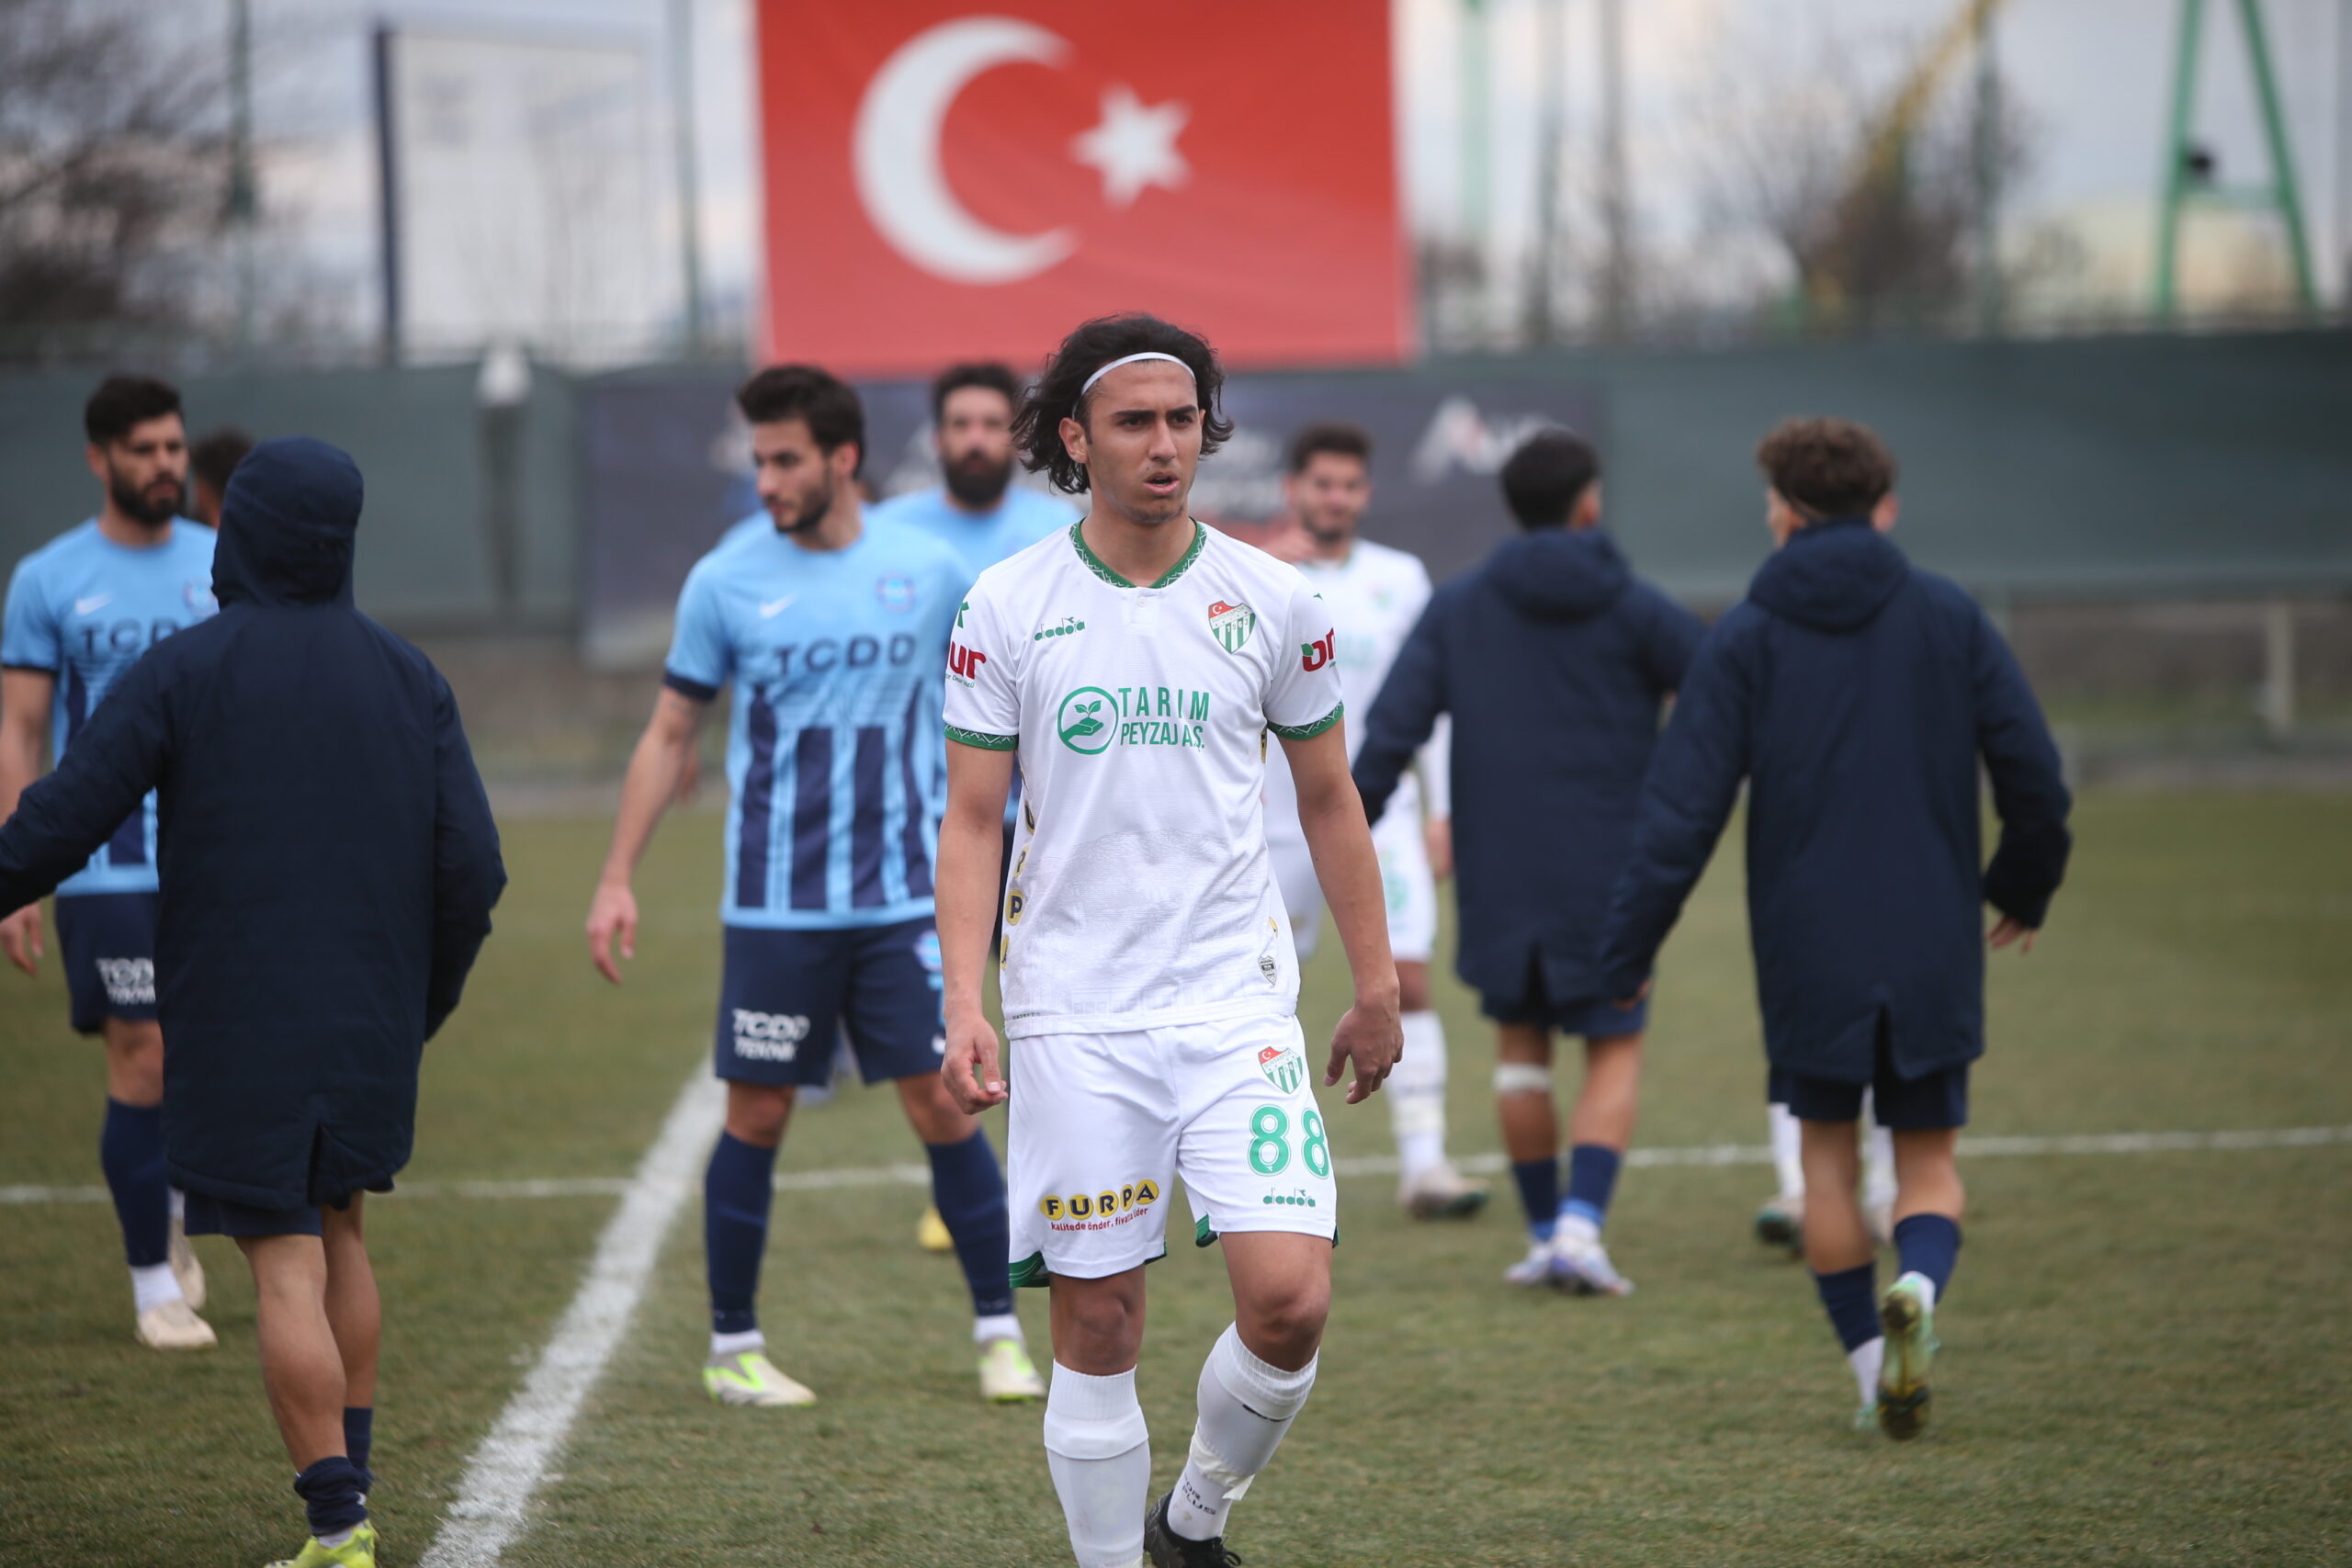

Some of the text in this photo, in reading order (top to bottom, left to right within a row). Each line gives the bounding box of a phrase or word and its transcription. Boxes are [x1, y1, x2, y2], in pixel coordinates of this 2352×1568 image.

[1034, 616, 1085, 641] diadora
[773, 633, 917, 676] TCDD
[1118, 687, 1209, 721] TARIM
[1120, 721, 1179, 746] PEYZAJ
[1248, 1103, 1330, 1180] 88
[1045, 1183, 1155, 1217] FURPA
[1262, 1186, 1317, 1208] diadora
